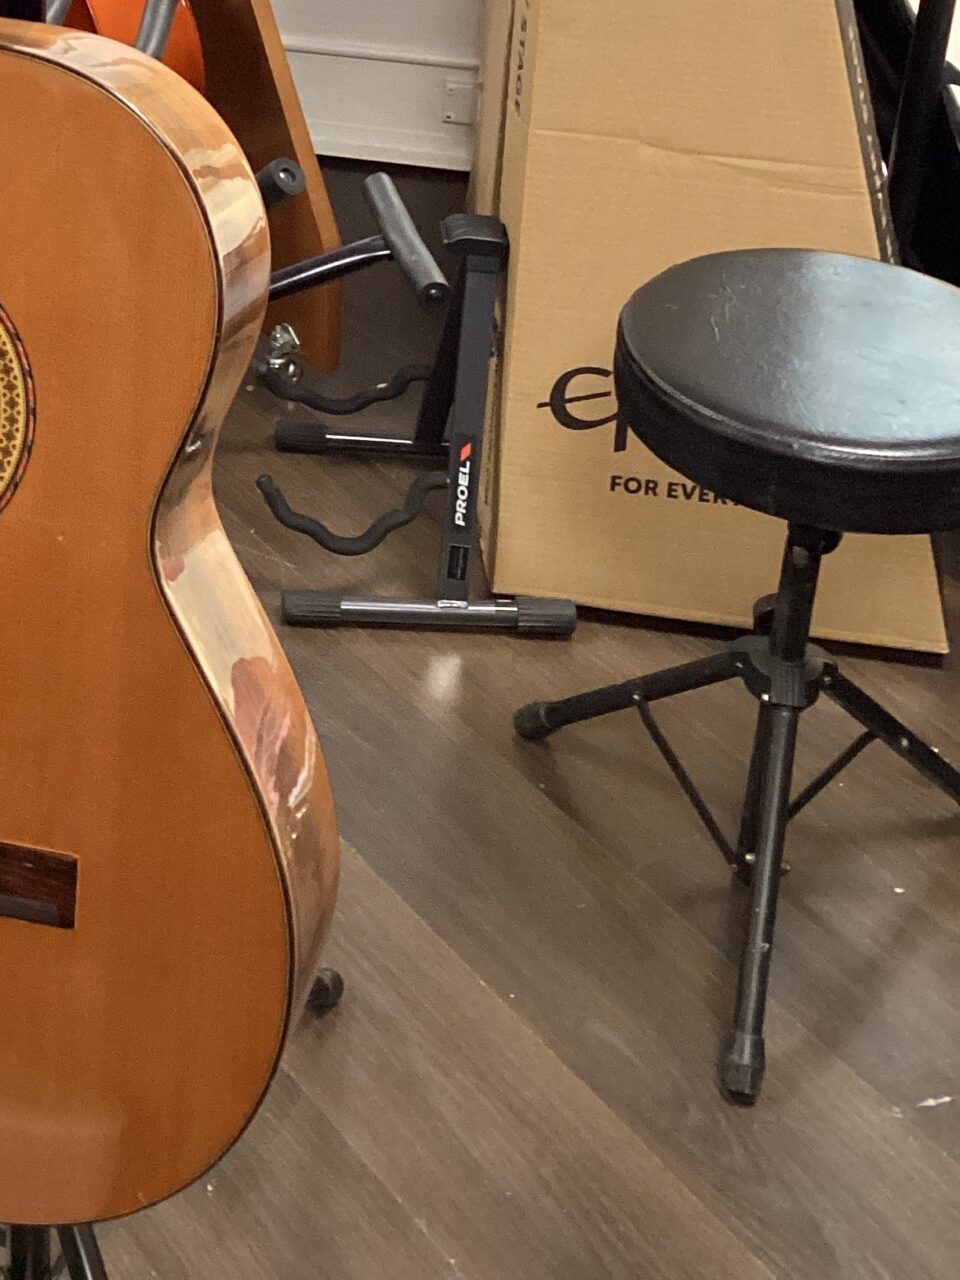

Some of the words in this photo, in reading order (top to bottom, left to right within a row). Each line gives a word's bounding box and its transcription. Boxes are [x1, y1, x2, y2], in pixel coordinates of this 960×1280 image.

[514, 14, 528, 119] STAGE
[454, 460, 471, 527] PROEL
[609, 475, 659, 497] FOR
[666, 481, 739, 506] EVER
